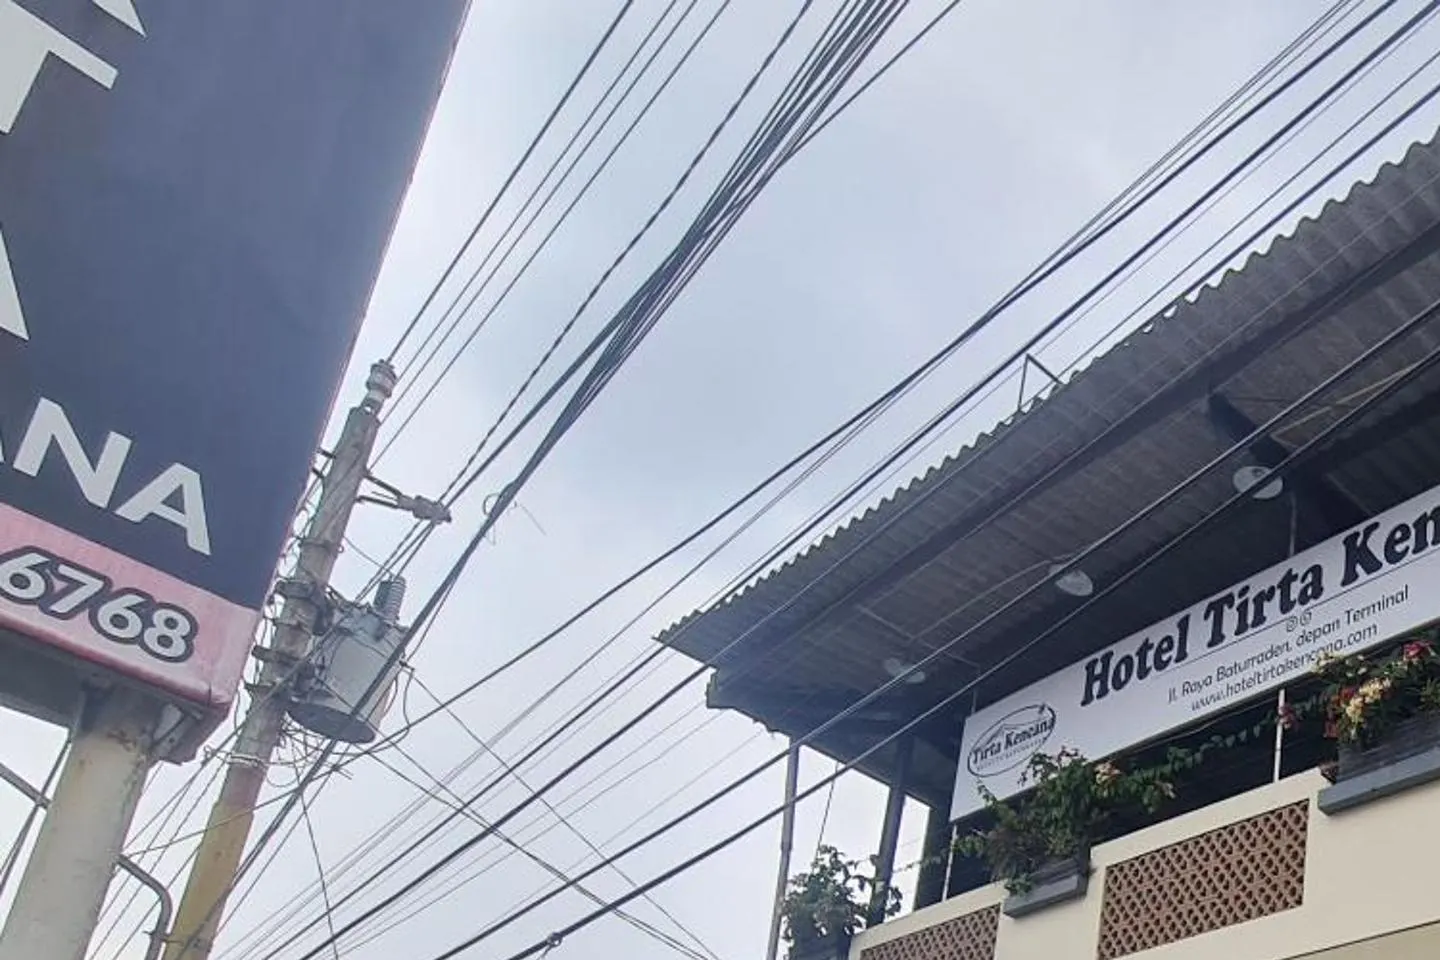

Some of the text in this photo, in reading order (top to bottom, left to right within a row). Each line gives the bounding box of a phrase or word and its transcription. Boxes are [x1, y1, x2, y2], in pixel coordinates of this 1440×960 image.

[0, 396, 211, 556] NA
[1080, 614, 1191, 707] Hotel
[1203, 563, 1325, 650] Tirta
[1181, 674, 1213, 698] Raya
[1295, 618, 1341, 648] depan
[1344, 582, 1409, 626] Terminal
